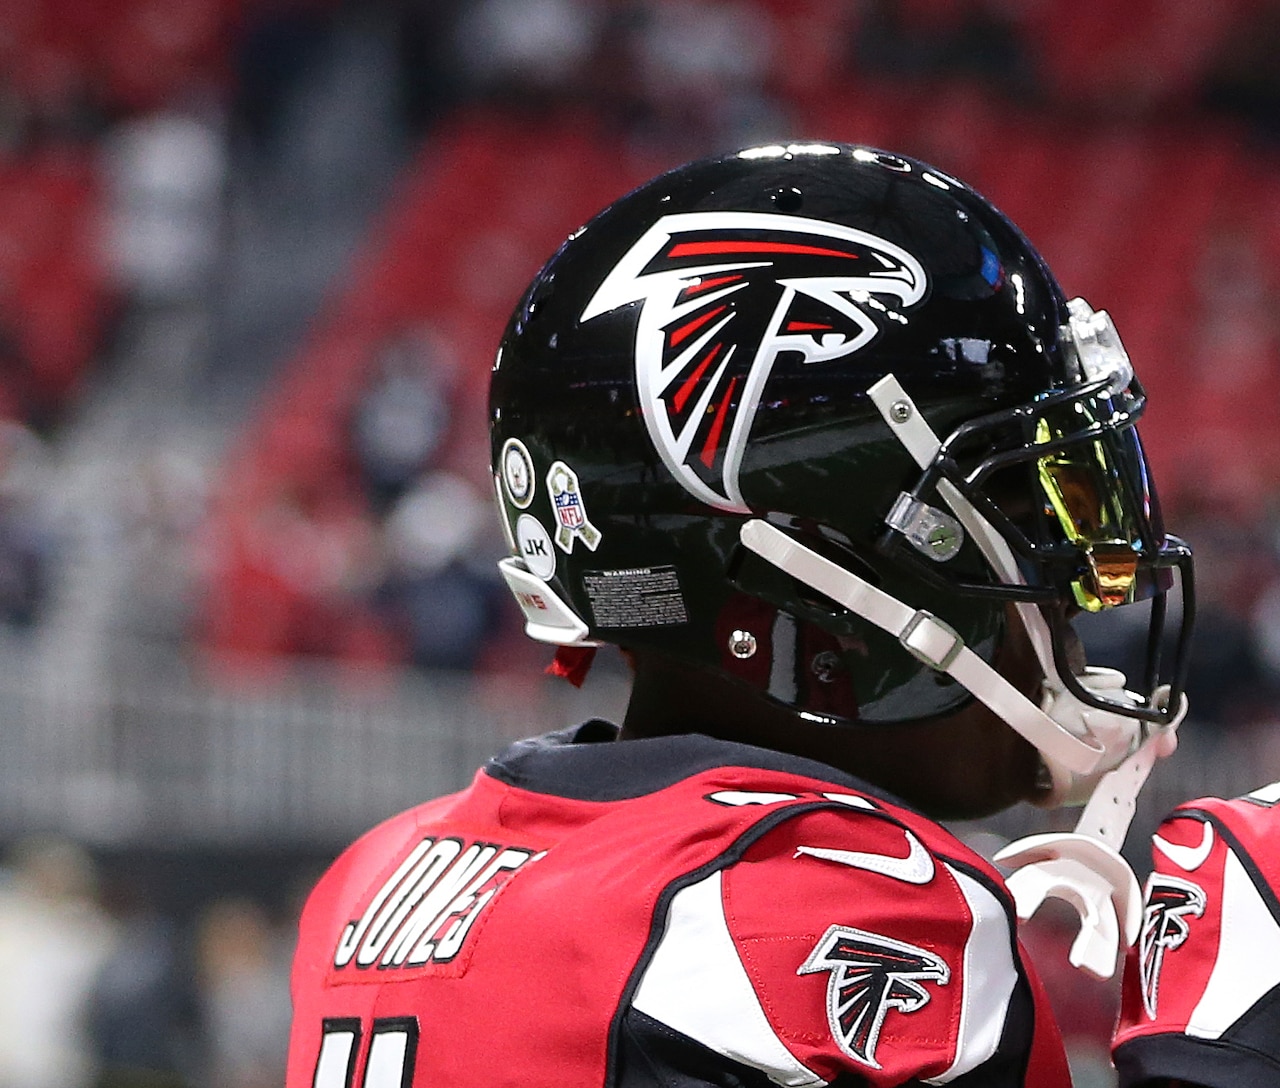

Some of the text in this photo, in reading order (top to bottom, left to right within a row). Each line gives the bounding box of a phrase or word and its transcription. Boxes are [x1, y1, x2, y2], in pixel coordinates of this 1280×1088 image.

[558, 507, 584, 525] NFL
[525, 539, 549, 556] JK
[602, 568, 652, 578] WARNING
